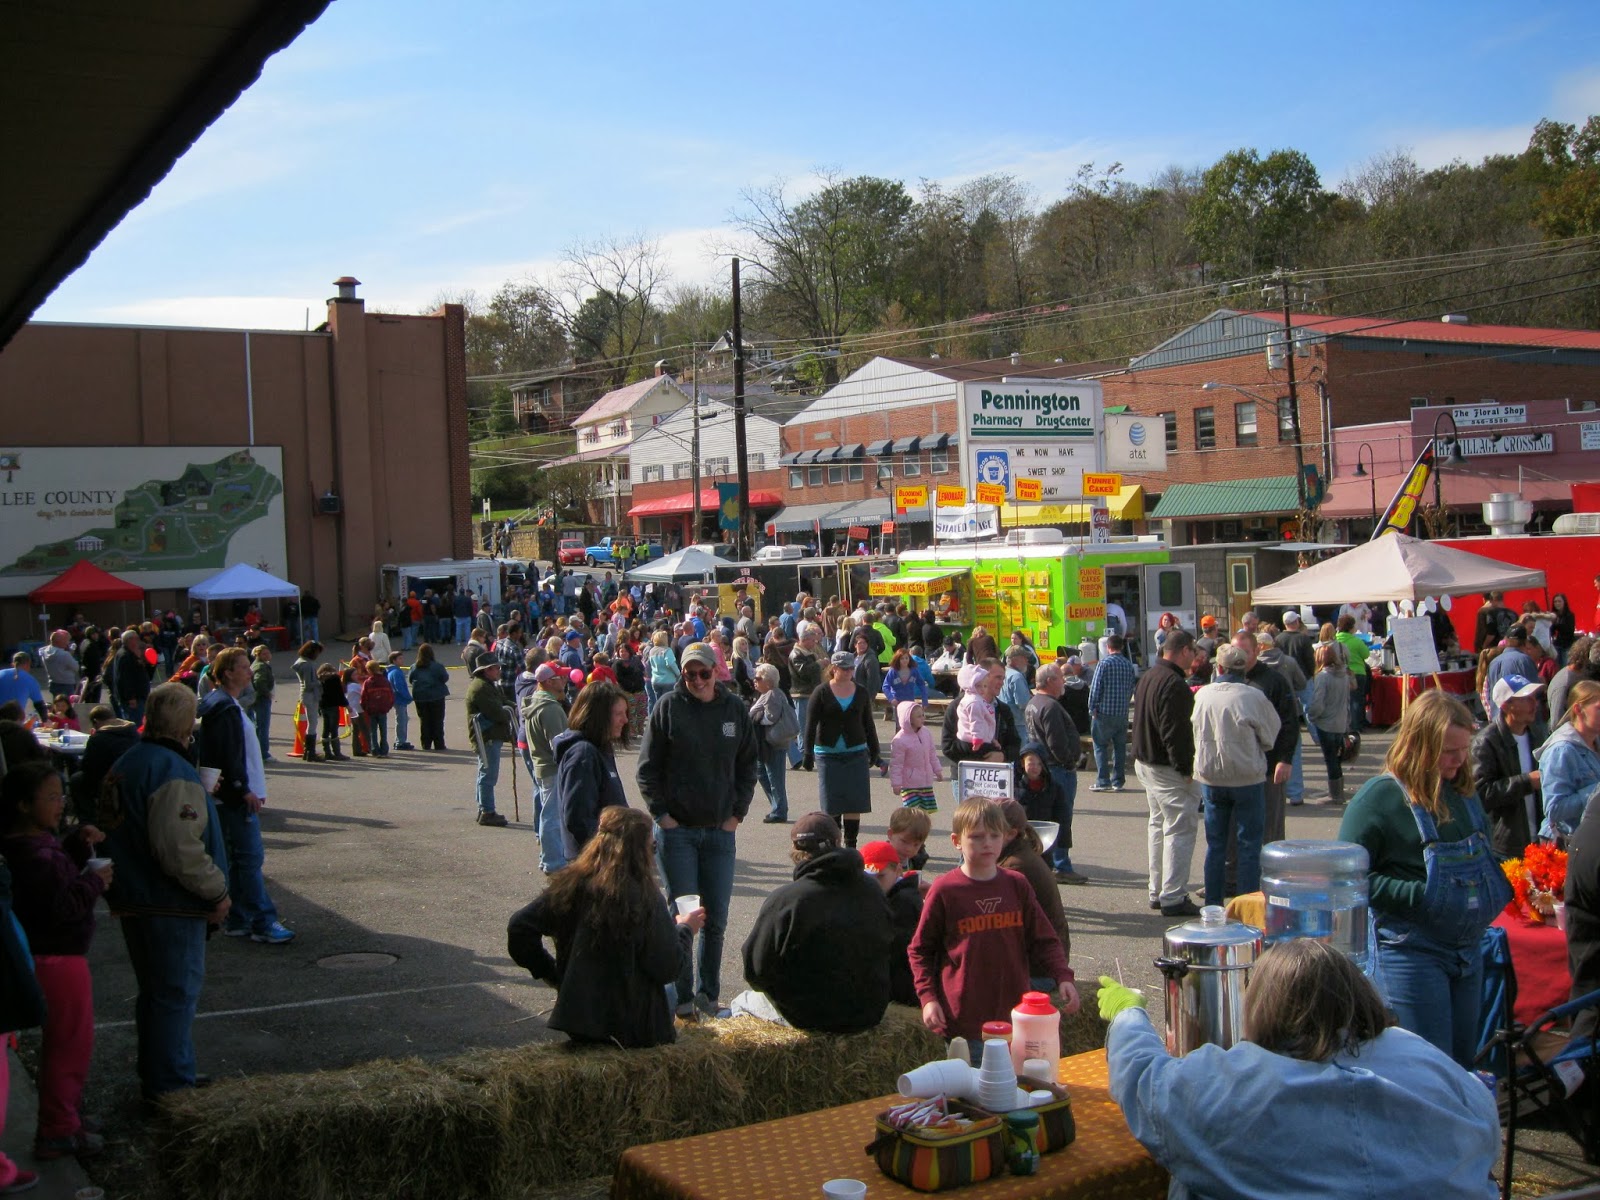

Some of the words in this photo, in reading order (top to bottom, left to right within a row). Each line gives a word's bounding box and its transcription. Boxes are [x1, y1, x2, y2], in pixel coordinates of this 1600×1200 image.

[981, 389, 1080, 416] Pennington
[1454, 410, 1468, 418] The
[1474, 408, 1500, 418] Floral
[1504, 406, 1524, 415] Shop
[973, 414, 1023, 428] Pharmacy
[1036, 415, 1091, 429] DrugCenter
[1016, 448, 1025, 456] WE
[1034, 448, 1048, 456] NOW
[1058, 448, 1074, 456] HAVE
[1462, 438, 1498, 455] ILLAGE
[1130, 449, 1146, 459] at&t
[1028, 468, 1047, 476] SWEET
[1087, 476, 1116, 484] FUNNEL
[2, 492, 36, 506] LEE
[44, 490, 116, 504] COUNTY
[980, 493, 1000, 503] FRIES
[1020, 490, 1037, 498] FRIES
[1070, 606, 1104, 618] LEMONADE
[974, 769, 1000, 782] FREE
[975, 897, 1002, 914] VT
[958, 910, 1023, 934] FOOTBALL
